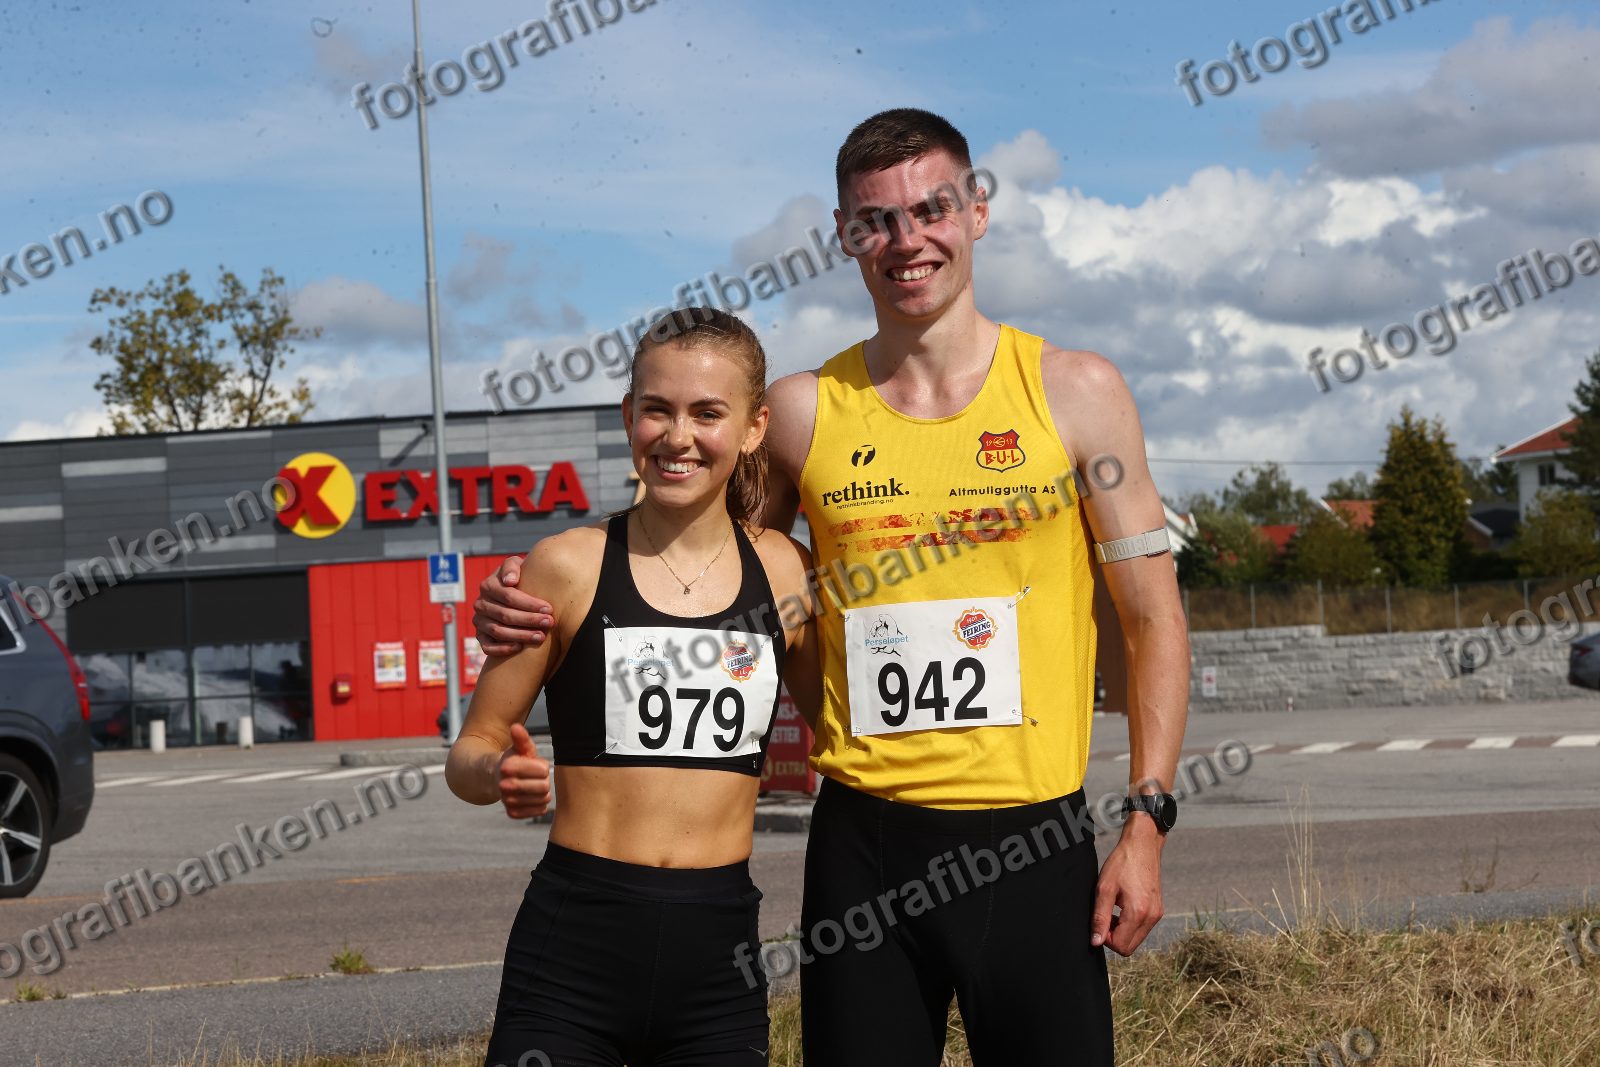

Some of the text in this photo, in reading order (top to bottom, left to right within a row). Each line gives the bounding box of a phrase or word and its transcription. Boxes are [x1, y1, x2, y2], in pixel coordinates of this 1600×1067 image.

[364, 460, 591, 522] EXTRA
[821, 477, 910, 507] rethink.
[949, 484, 1056, 497] Altmuliggutta AS
[865, 634, 909, 647] Perseløpet
[963, 621, 991, 638] FEIRING
[878, 656, 988, 727] 942
[638, 685, 745, 752] 979
